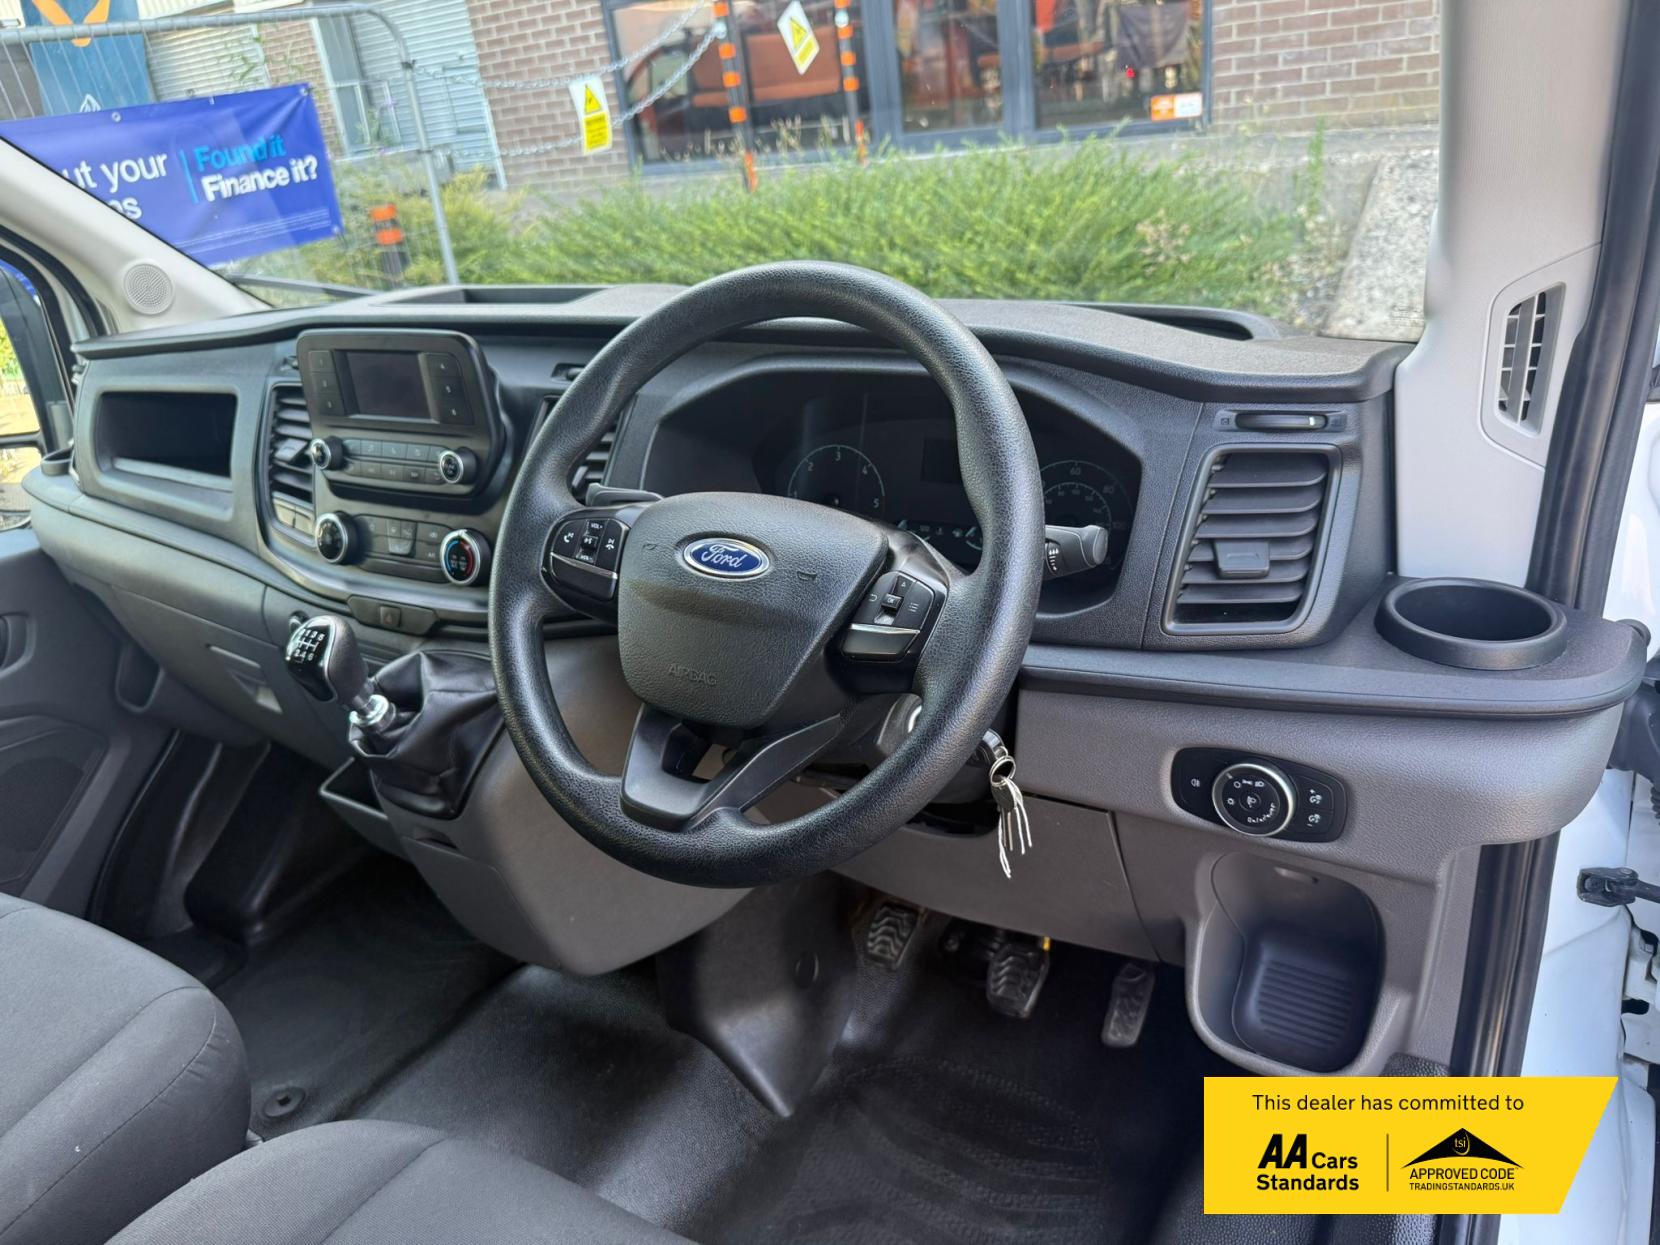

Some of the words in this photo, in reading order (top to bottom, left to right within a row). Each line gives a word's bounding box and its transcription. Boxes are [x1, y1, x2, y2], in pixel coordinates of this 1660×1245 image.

[193, 138, 268, 172] Found
[268, 134, 287, 158] it
[100, 153, 168, 193] your
[201, 166, 290, 202] Finance
[291, 154, 318, 184] it?
[701, 544, 746, 568] Ford
